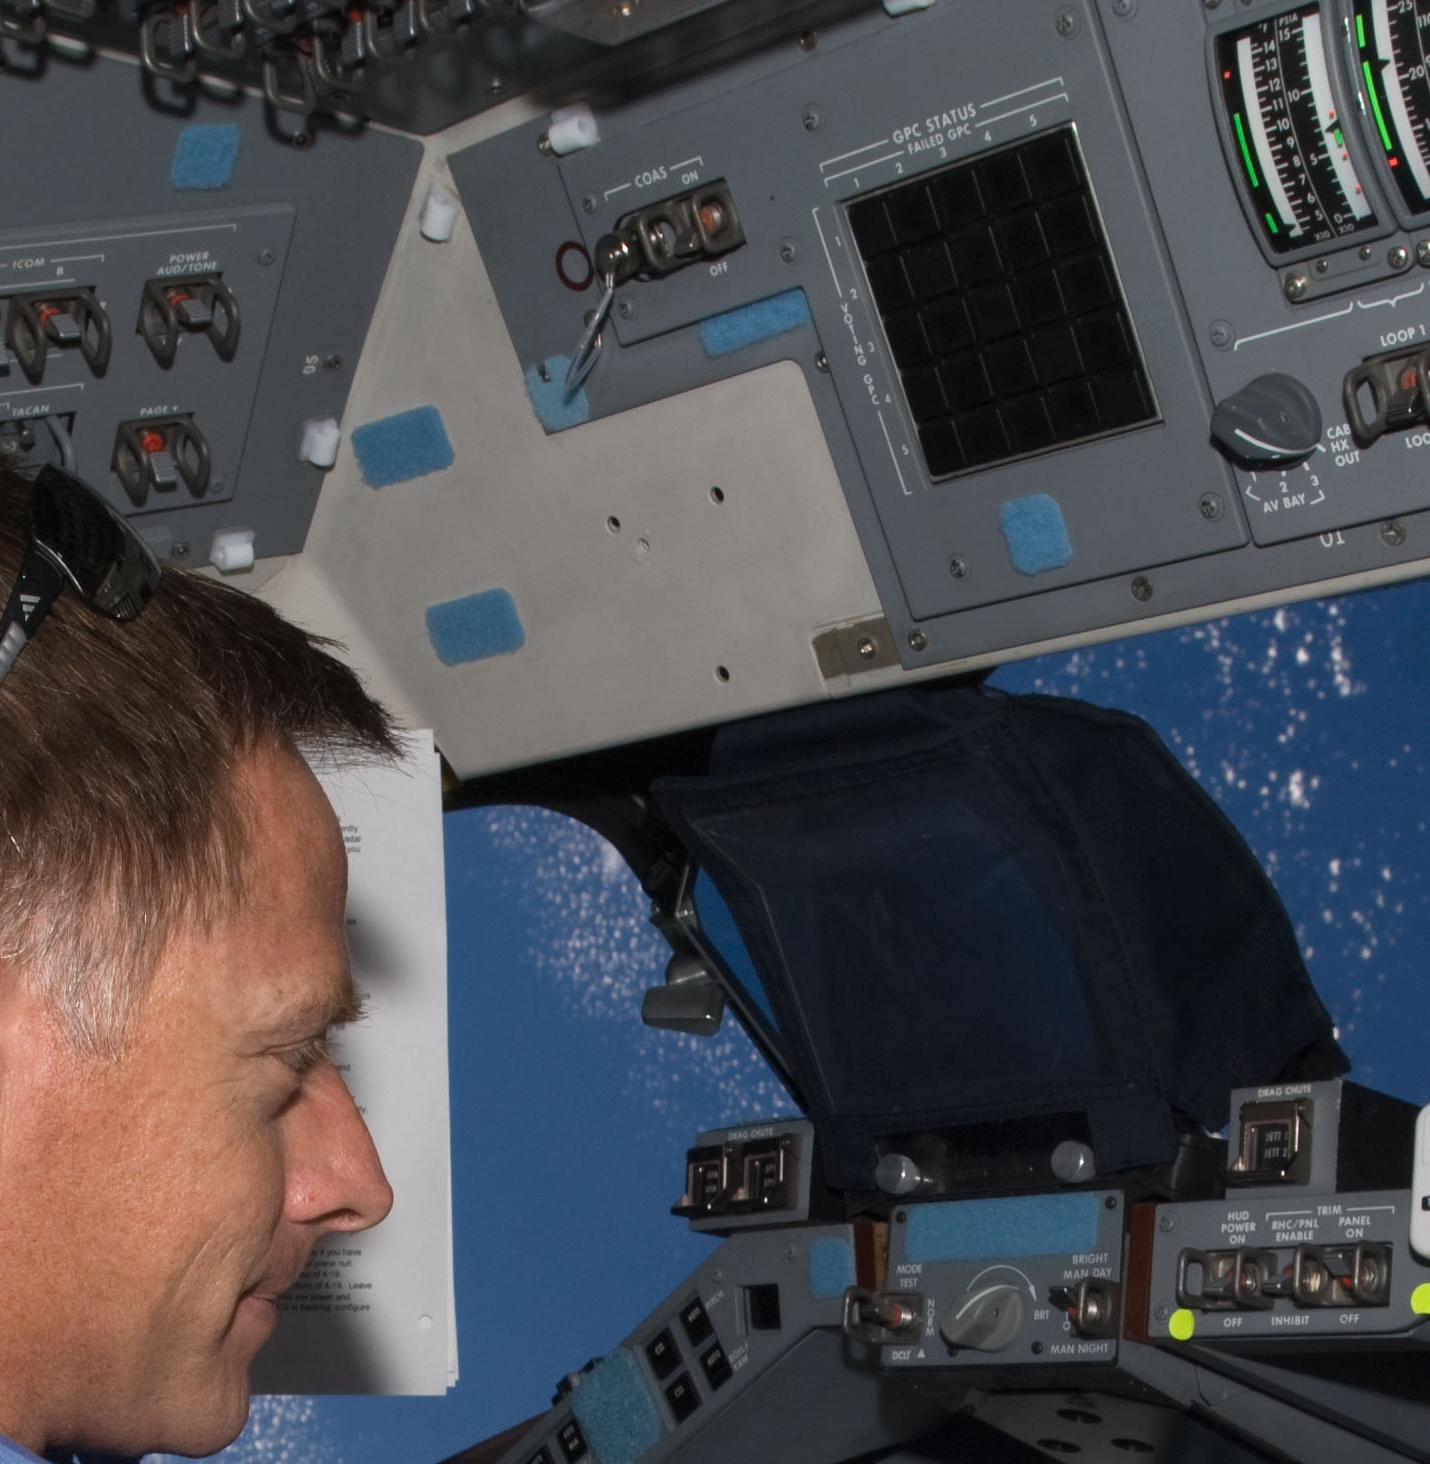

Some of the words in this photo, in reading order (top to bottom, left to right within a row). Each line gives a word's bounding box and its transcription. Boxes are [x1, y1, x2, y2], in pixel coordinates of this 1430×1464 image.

[1278, 14, 1299, 27] PSIA
[1409, 65, 1425, 80] 20
[892, 118, 922, 146] GPC
[925, 103, 977, 132] STATUS
[907, 133, 944, 156] FAILED
[947, 122, 972, 143] GPC
[634, 166, 668, 189] COAS
[681, 170, 700, 186] ON
[12, 258, 45, 270] ICOM
[170, 251, 209, 264] POWER
[157, 261, 218, 276] AUD/TONE
[709, 261, 729, 277] OFF
[840, 303, 867, 367] VOTING
[1380, 327, 1417, 347] LOOP
[1420, 324, 1427, 337] 1
[12, 404, 50, 417] TACAN
[1326, 424, 1351, 439] CAB
[1331, 440, 1349, 452] HX
[1335, 451, 1360, 468] OUT
[1263, 499, 1279, 513] AV
[1283, 493, 1306, 509] BAY
[1258, 1087, 1284, 1098] DRAG
[1285, 1084, 1312, 1095] CHUTE
[1227, 1211, 1250, 1221] HUD
[1317, 1205, 1342, 1216] TRIM
[1221, 1222, 1256, 1233] POWER
[1272, 1218, 1319, 1230] RHC/PNL
[1338, 1216, 1371, 1227] PANEL
[1229, 1234, 1246, 1244] ON
[1276, 1230, 1314, 1241] ENABLE
[1346, 1228, 1364, 1239] ON
[1072, 1252, 1109, 1264] BRIGHT
[896, 1264, 922, 1275] MODE
[1063, 1269, 1089, 1280] MAN
[1092, 1267, 1113, 1279] DAY
[900, 1278, 918, 1289] TEST
[926, 1298, 935, 1337] NORM
[1034, 1309, 1050, 1321] BRT
[1271, 1315, 1310, 1326] INHIBIT
[1339, 1314, 1360, 1324] OFF
[1223, 1317, 1243, 1328] OFF
[1051, 1343, 1075, 1355] MAN
[1077, 1342, 1109, 1354] NIGHT
[892, 1350, 911, 1361] DCLT
